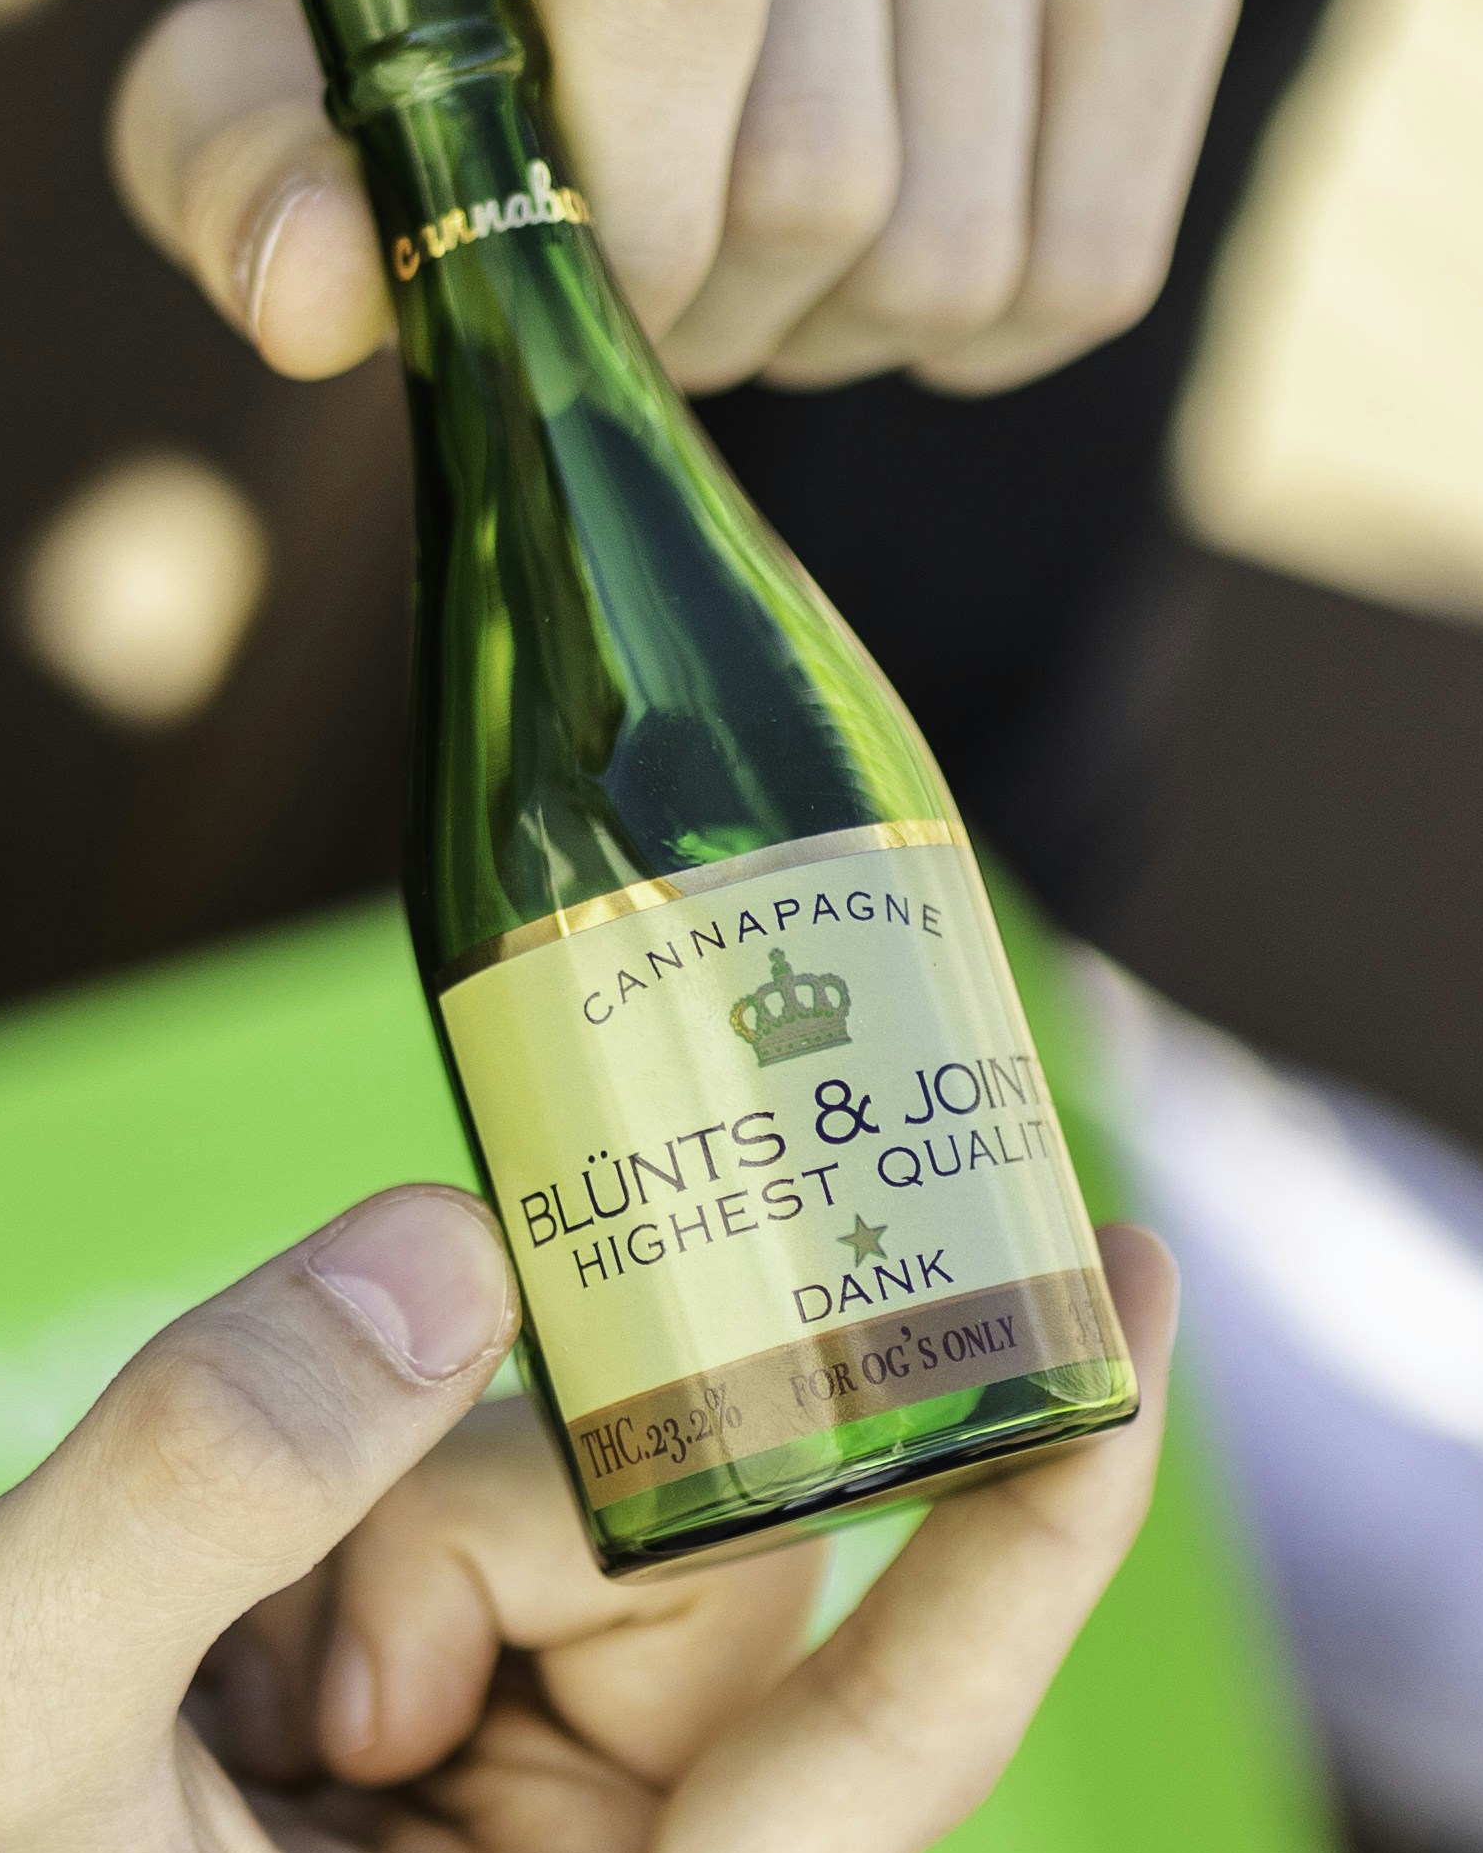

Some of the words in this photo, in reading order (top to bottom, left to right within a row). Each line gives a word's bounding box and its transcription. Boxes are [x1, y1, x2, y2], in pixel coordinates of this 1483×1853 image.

[582, 890, 943, 1025] CANNAPAGNE
[519, 1110, 787, 1249] BLÜNTS
[814, 1079, 881, 1145] &
[572, 1161, 840, 1289] HIGHEST
[791, 1248, 955, 1325] DANK
[788, 1360, 860, 1410] FOR
[942, 1314, 1019, 1363] ONLY
